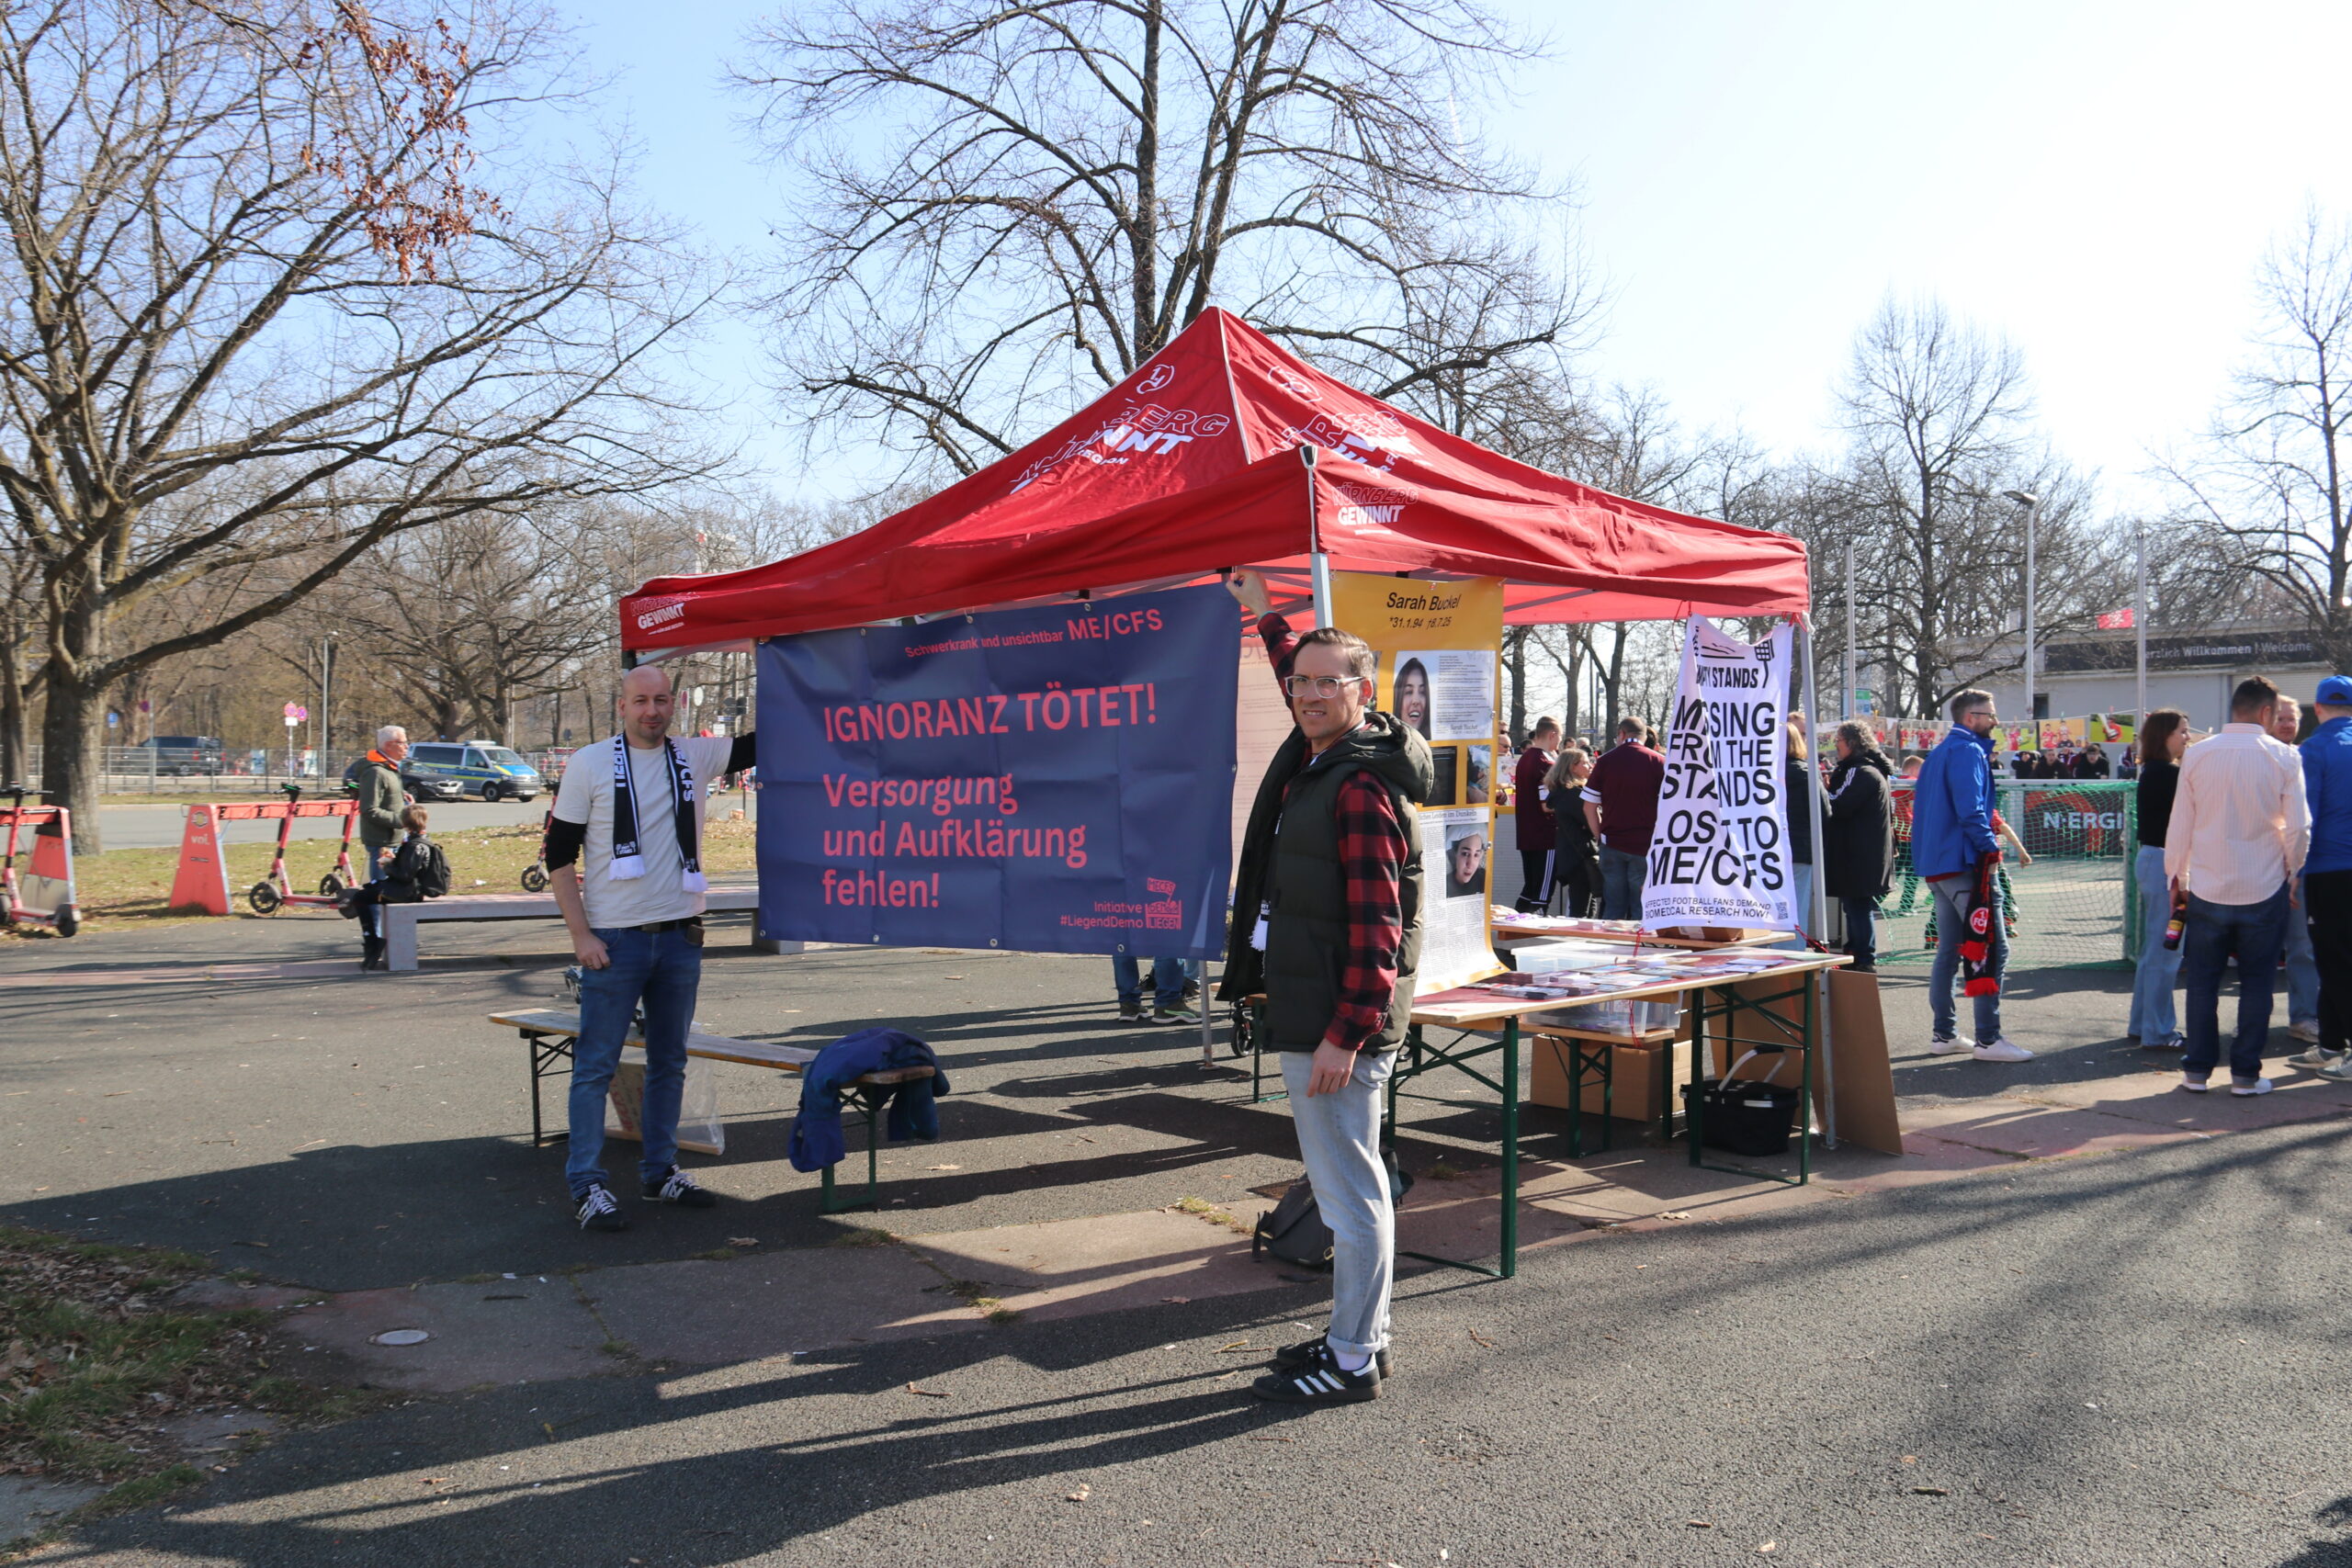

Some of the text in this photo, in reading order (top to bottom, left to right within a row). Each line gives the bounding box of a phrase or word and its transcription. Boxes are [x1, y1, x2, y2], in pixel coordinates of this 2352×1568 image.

[1331, 482, 1419, 506] NÜRNBERG
[1338, 505, 1406, 525] GEWINNT
[1387, 592, 1462, 611] Sarah Buckel
[638, 603, 685, 630] GEWINNT
[905, 608, 1164, 659] Schwerkrank und unsichtbar ME/CFS
[2183, 643, 2252, 657] Willkommen
[2261, 641, 2312, 653] Welcome
[1713, 667, 1758, 689] STANDS
[824, 682, 1157, 743] IGNORANZ TÖTET!
[1726, 739, 1773, 768] THE
[823, 773, 1018, 816] Versorgung
[823, 818, 1088, 869] und Aufklärung
[1737, 816, 1779, 852] TO
[1649, 845, 1784, 891] ME/CFS
[822, 868, 940, 908] fehlen!
[1094, 900, 1143, 913] Initiative
[1645, 897, 1771, 910] AFFECTED FOOTBALL FANS DEMAND
[1689, 907, 1740, 917] RESEARCH
[1743, 908, 1770, 919] NOW!
[1059, 915, 1144, 930] #LiegendDemo
